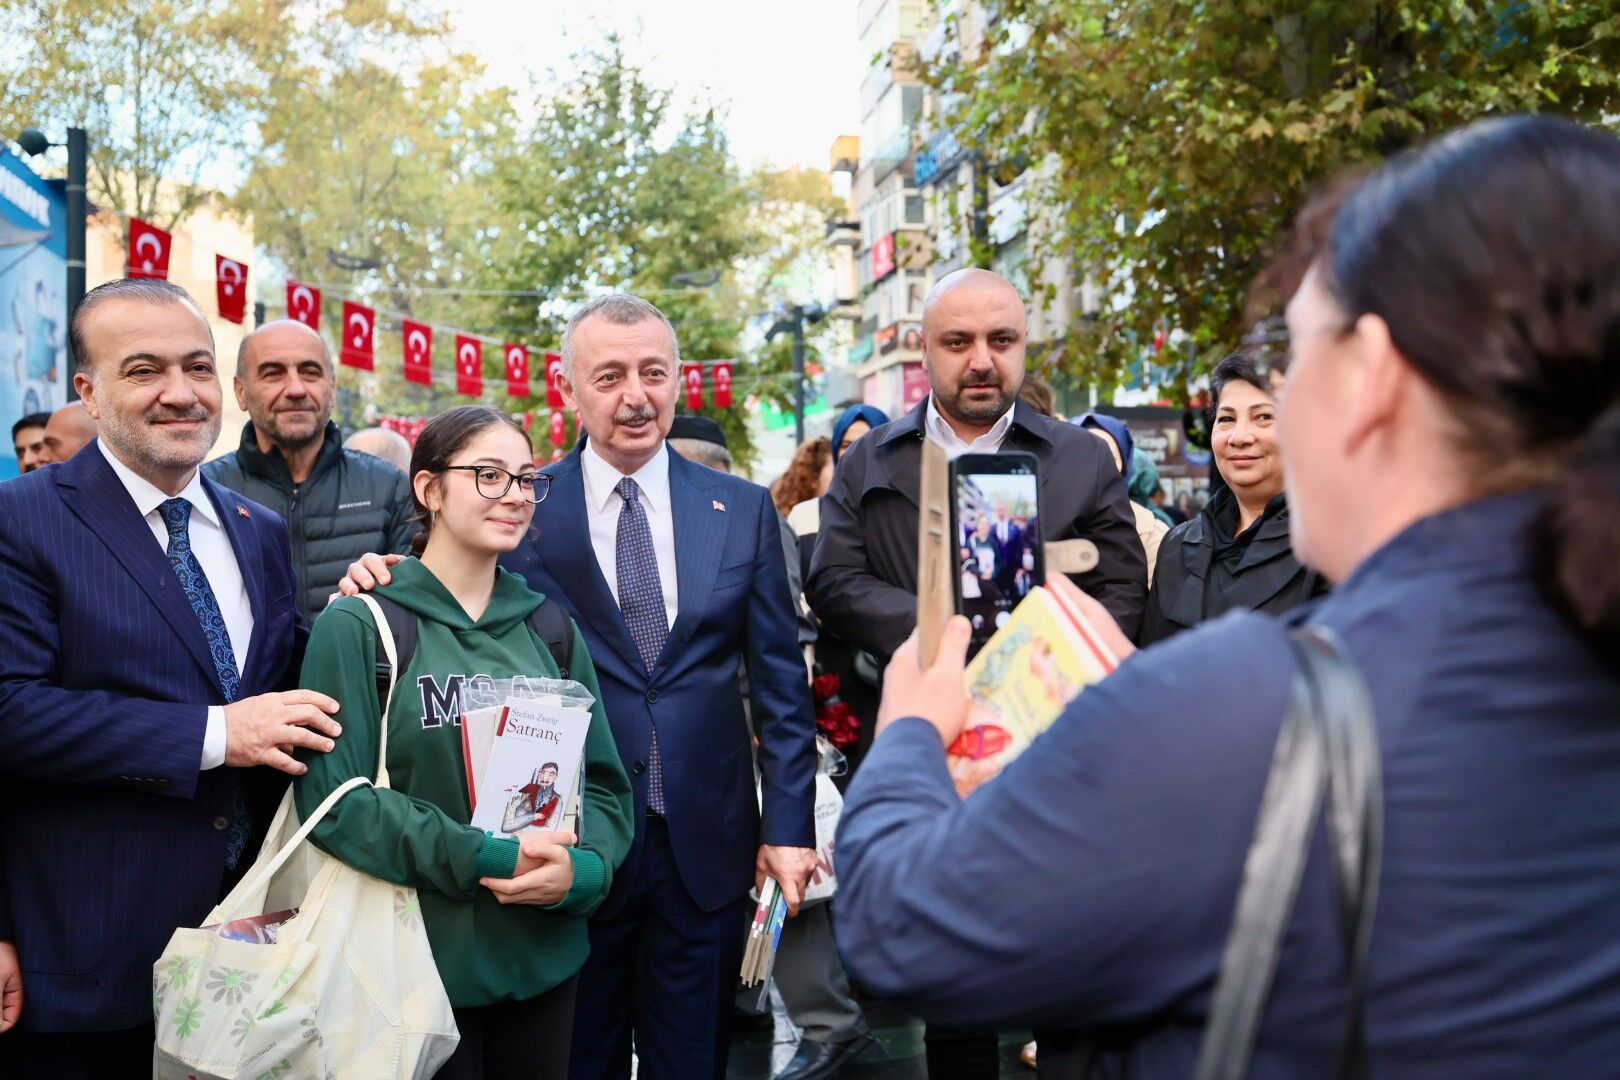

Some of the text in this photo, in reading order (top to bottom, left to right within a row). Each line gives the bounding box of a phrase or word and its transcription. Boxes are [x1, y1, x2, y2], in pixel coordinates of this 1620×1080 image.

[511, 707, 558, 725] Stefan Zweig
[506, 718, 562, 745] Satranç
